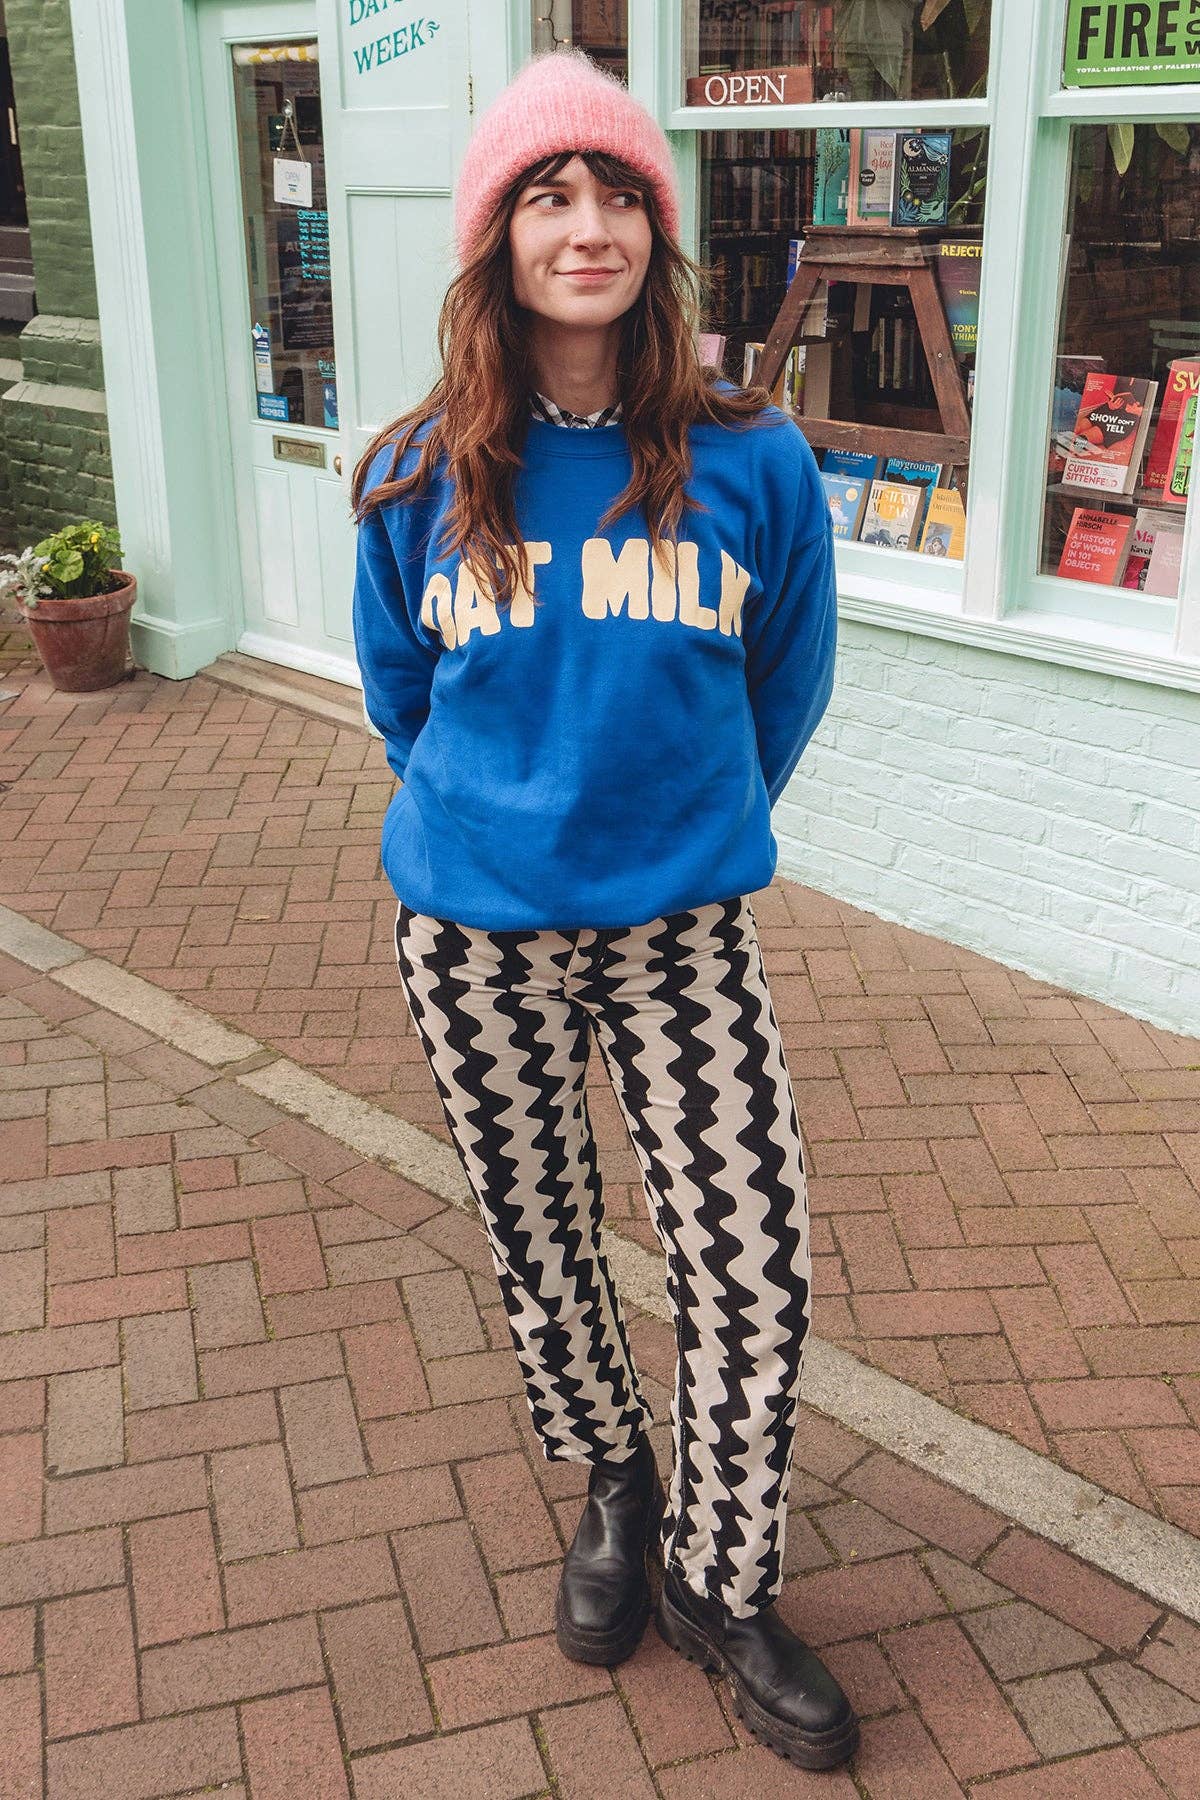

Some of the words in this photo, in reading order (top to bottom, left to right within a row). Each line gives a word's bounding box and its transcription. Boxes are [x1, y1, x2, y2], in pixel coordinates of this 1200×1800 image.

[349, 0, 404, 26] DA
[1077, 0, 1180, 60] FIRE
[353, 17, 425, 74] WEEK
[1103, 64, 1151, 72] LIBERATION
[705, 74, 787, 105] OPEN
[908, 165, 941, 173] ALMANAC
[953, 324, 977, 333] TONY
[1090, 412, 1118, 424] SHOW
[1106, 424, 1125, 434] TELL
[889, 458, 937, 473] playground
[1067, 463, 1099, 476] CURTIS
[1066, 472, 1118, 487] SITTENFED
[872, 489, 920, 506] HISHAM
[873, 502, 909, 518] MATAR
[1078, 513, 1118, 525] ANNABELLE
[1077, 521, 1103, 531] HIRSCH
[1080, 534, 1117, 546] HISTORY
[1067, 549, 1078, 558] IN
[1078, 551, 1092, 560] 101
[1083, 542, 1117, 555] WOMEN
[1065, 559, 1102, 571] OBJECTS
[421, 541, 552, 651] OAT
[582, 538, 751, 638] MILK
